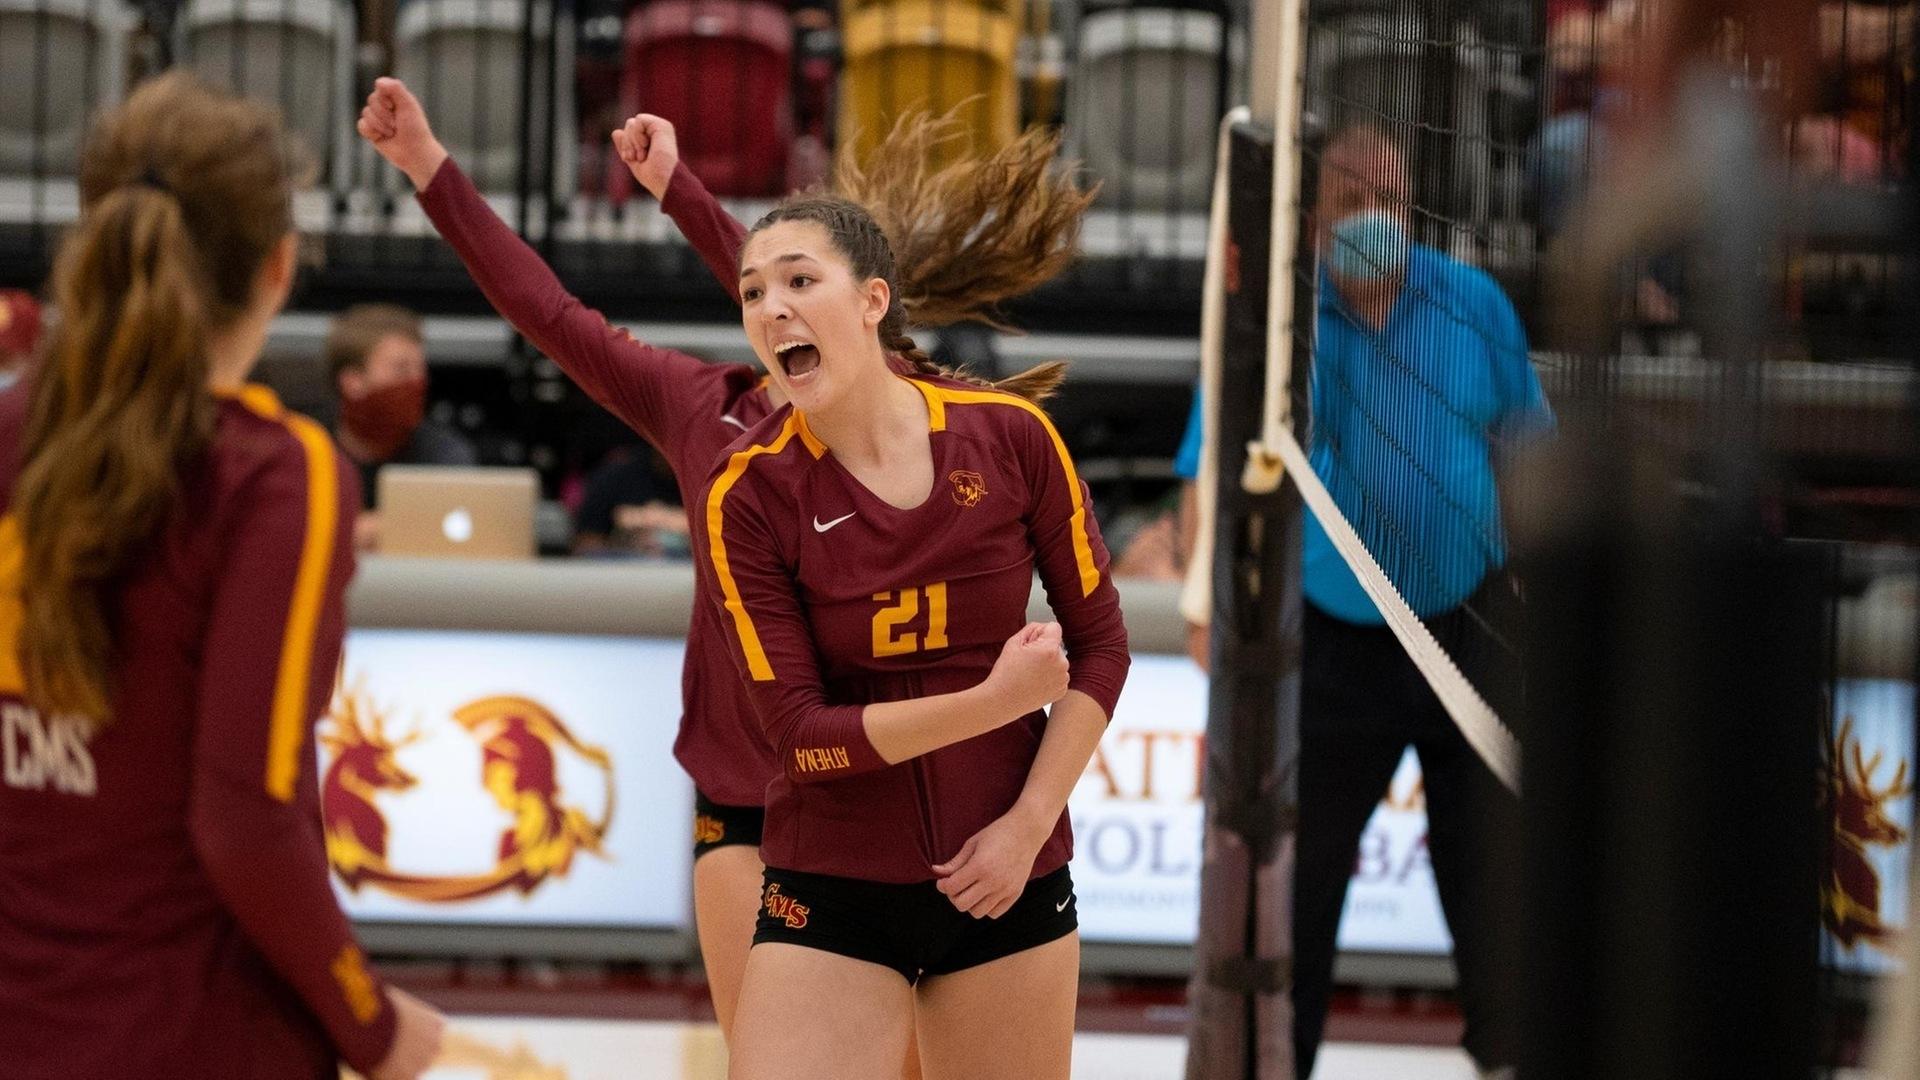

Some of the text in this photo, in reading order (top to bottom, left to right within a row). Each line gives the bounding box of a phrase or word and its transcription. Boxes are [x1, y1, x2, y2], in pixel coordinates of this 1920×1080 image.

[872, 581, 948, 658] 21
[2, 704, 98, 796] CMS
[795, 746, 850, 773] ATHENA
[764, 883, 810, 929] CMS
